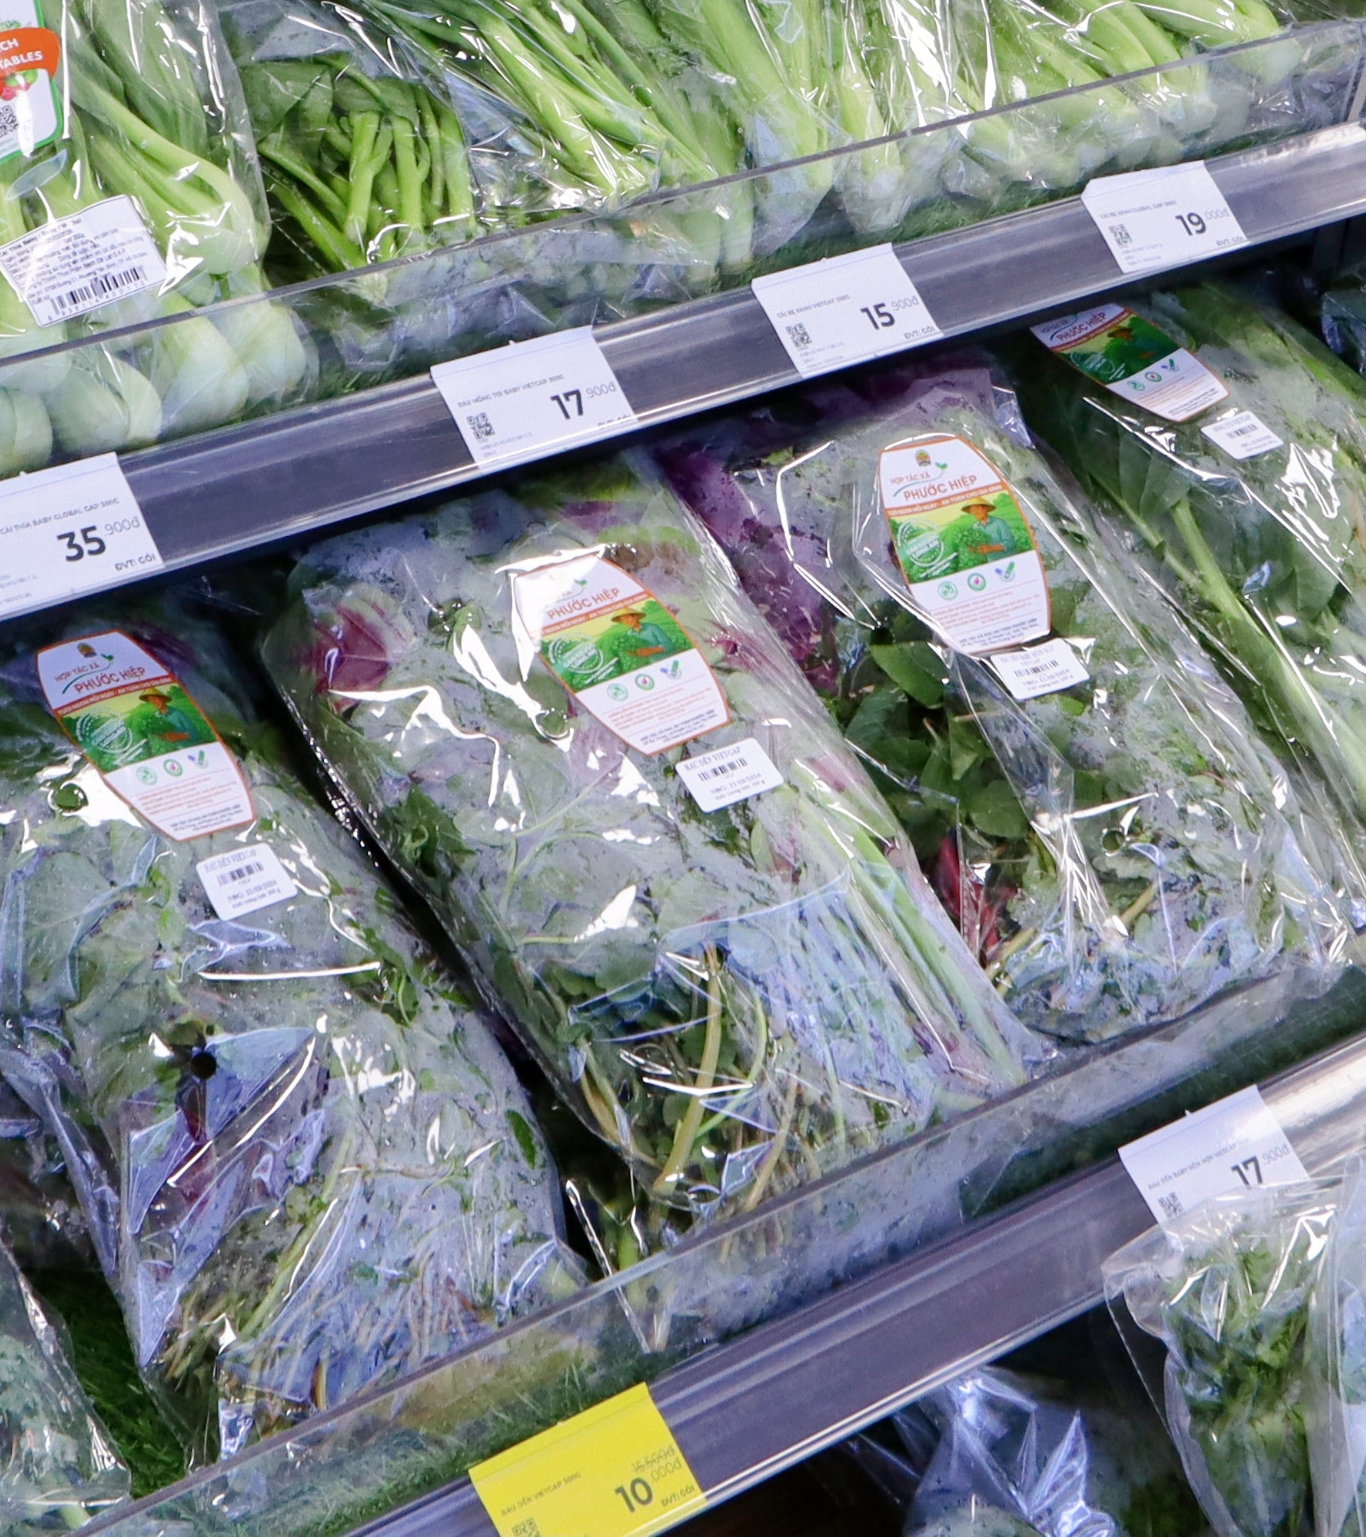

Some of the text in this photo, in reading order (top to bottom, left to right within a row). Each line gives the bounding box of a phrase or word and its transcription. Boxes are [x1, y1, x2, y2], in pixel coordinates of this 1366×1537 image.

[1175, 212, 1207, 236] 19
[860, 302, 896, 331] 15
[550, 389, 584, 420] 17
[903, 474, 979, 502] PHƯỚC HIỆP
[56, 525, 107, 562] 35
[547, 588, 621, 620] PHƯỚC HIỆP
[73, 665, 146, 695] PHƯỚC HIỆP
[1231, 1155, 1264, 1192] 17
[614, 1476, 654, 1514] 10
